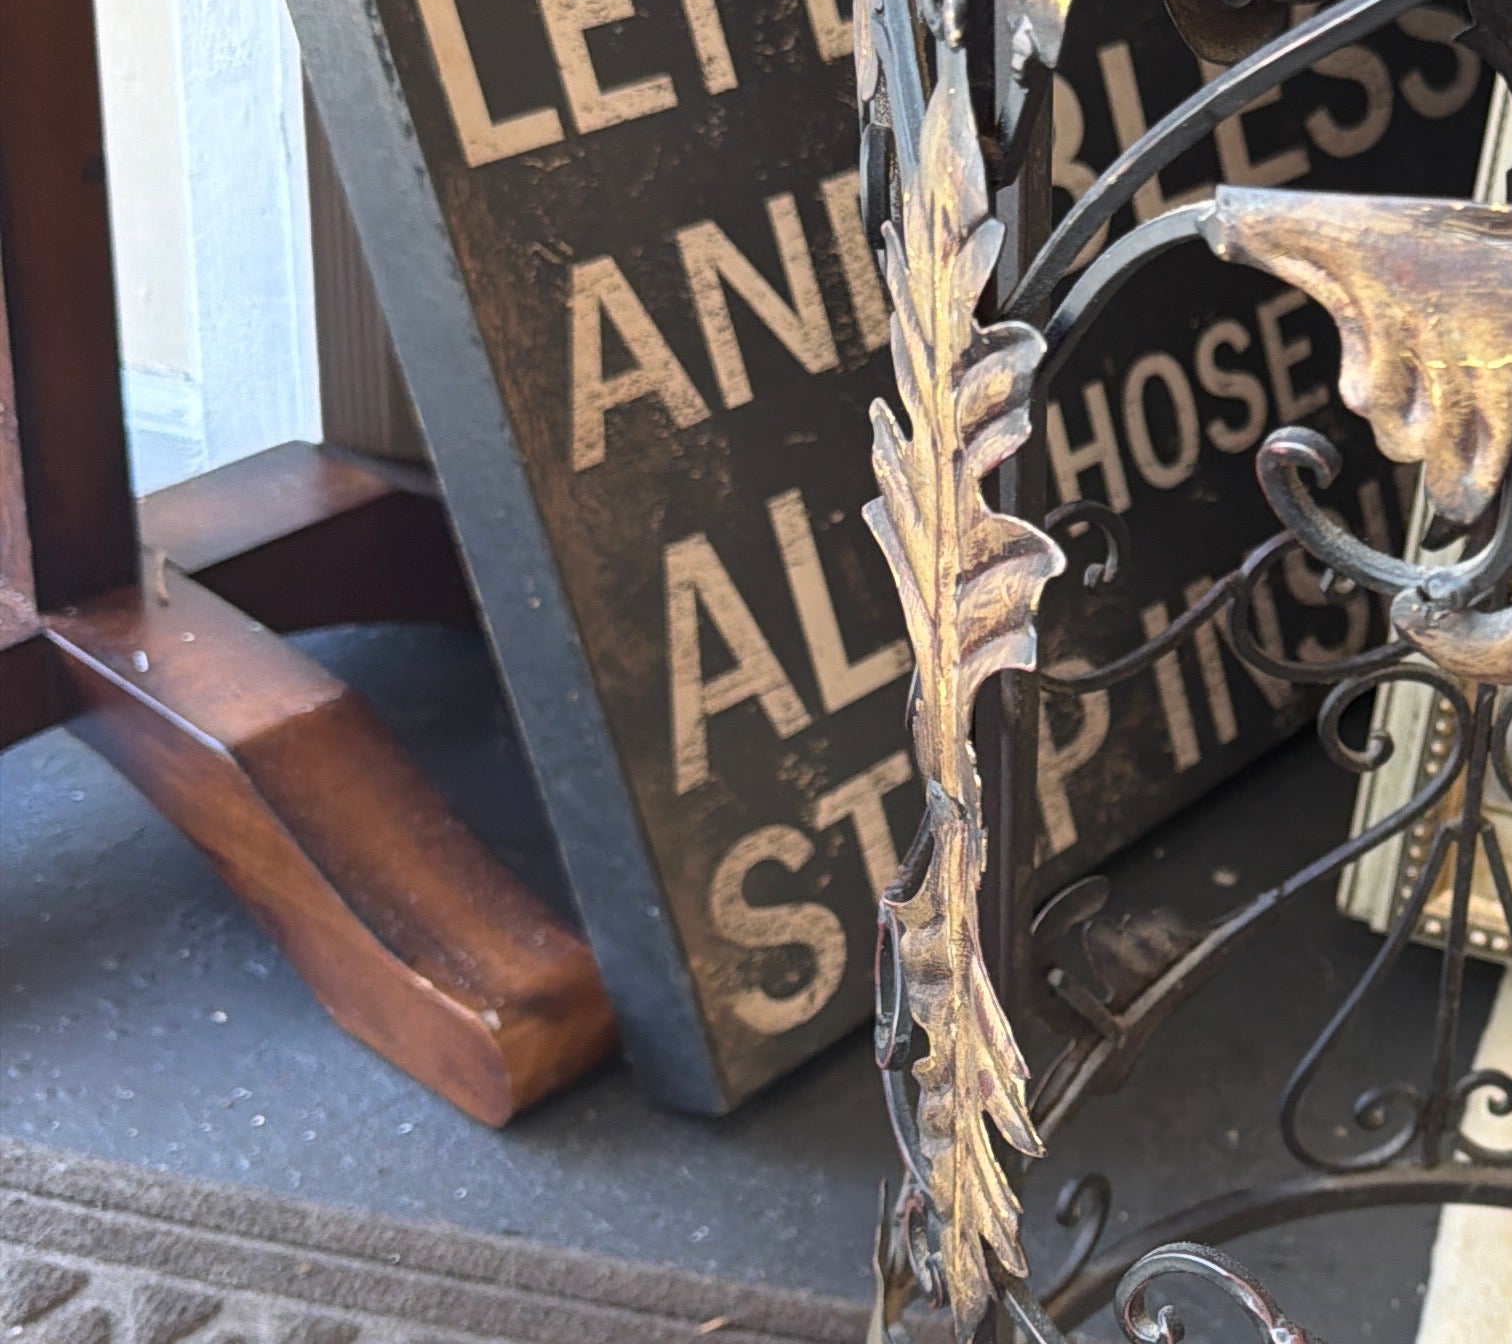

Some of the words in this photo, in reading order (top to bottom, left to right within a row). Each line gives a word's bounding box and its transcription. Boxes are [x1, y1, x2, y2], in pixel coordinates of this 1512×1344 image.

[664, 488, 912, 796] AL
[1047, 286, 1331, 538] HOSE
[708, 657, 1112, 1036] STP
